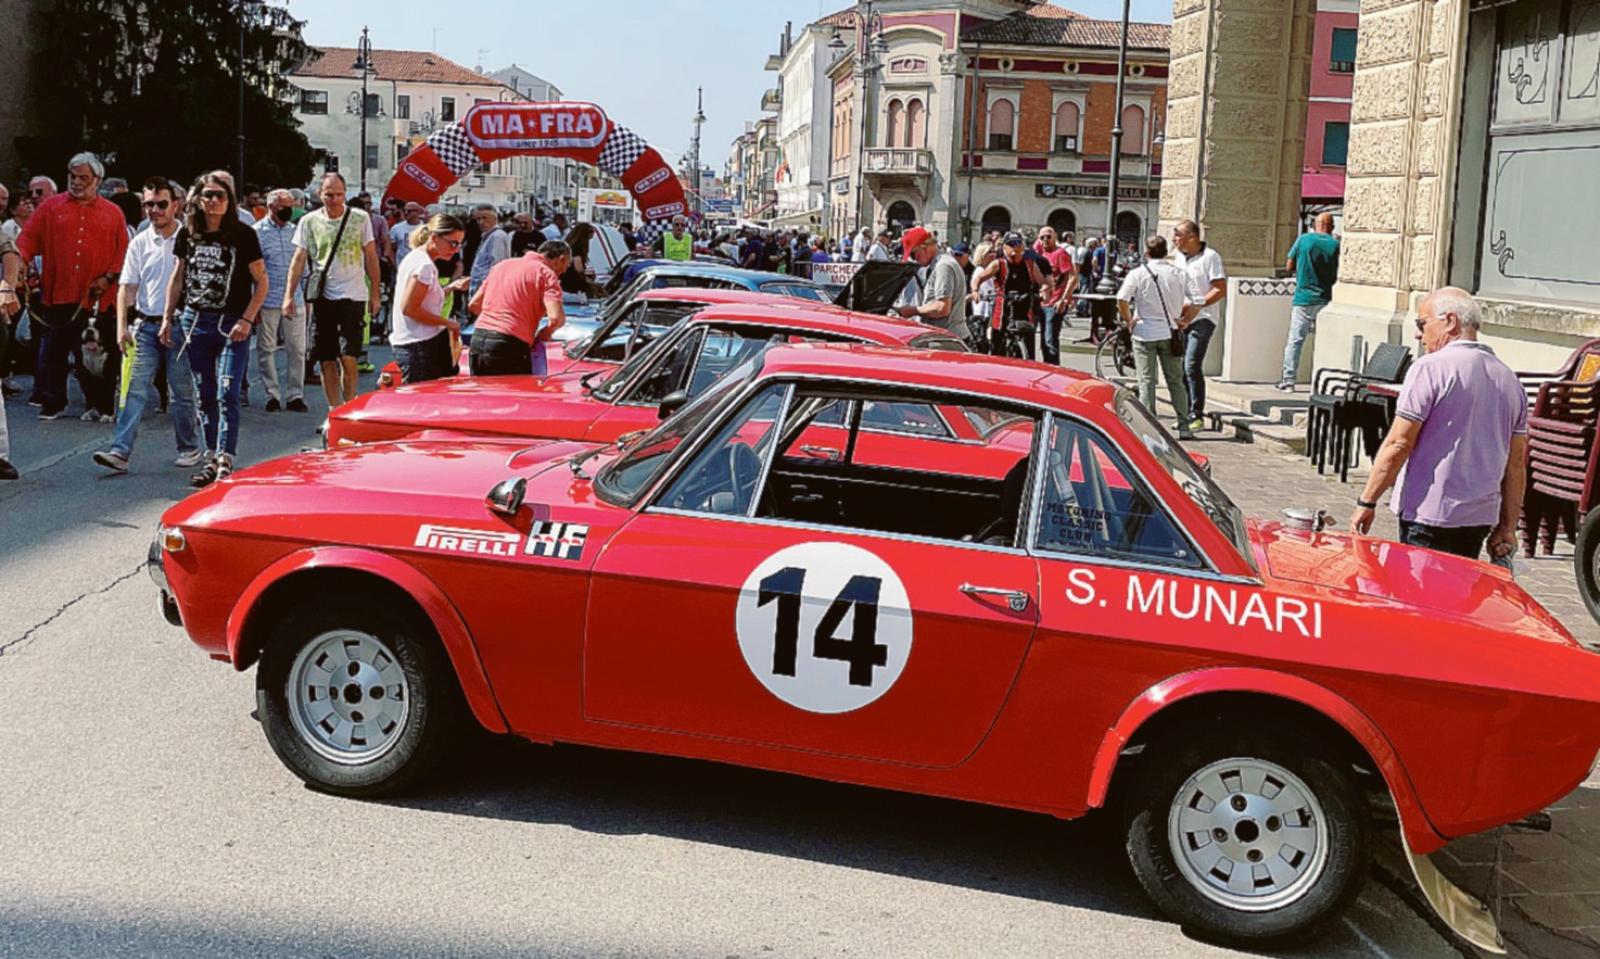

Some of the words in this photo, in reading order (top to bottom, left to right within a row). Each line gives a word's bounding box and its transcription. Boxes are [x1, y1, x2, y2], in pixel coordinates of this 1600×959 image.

[414, 524, 521, 556] PIRELLI
[524, 519, 589, 559] HF
[757, 566, 888, 688] 14
[1065, 568, 1106, 608] S.
[1125, 575, 1323, 639] MUNARI
